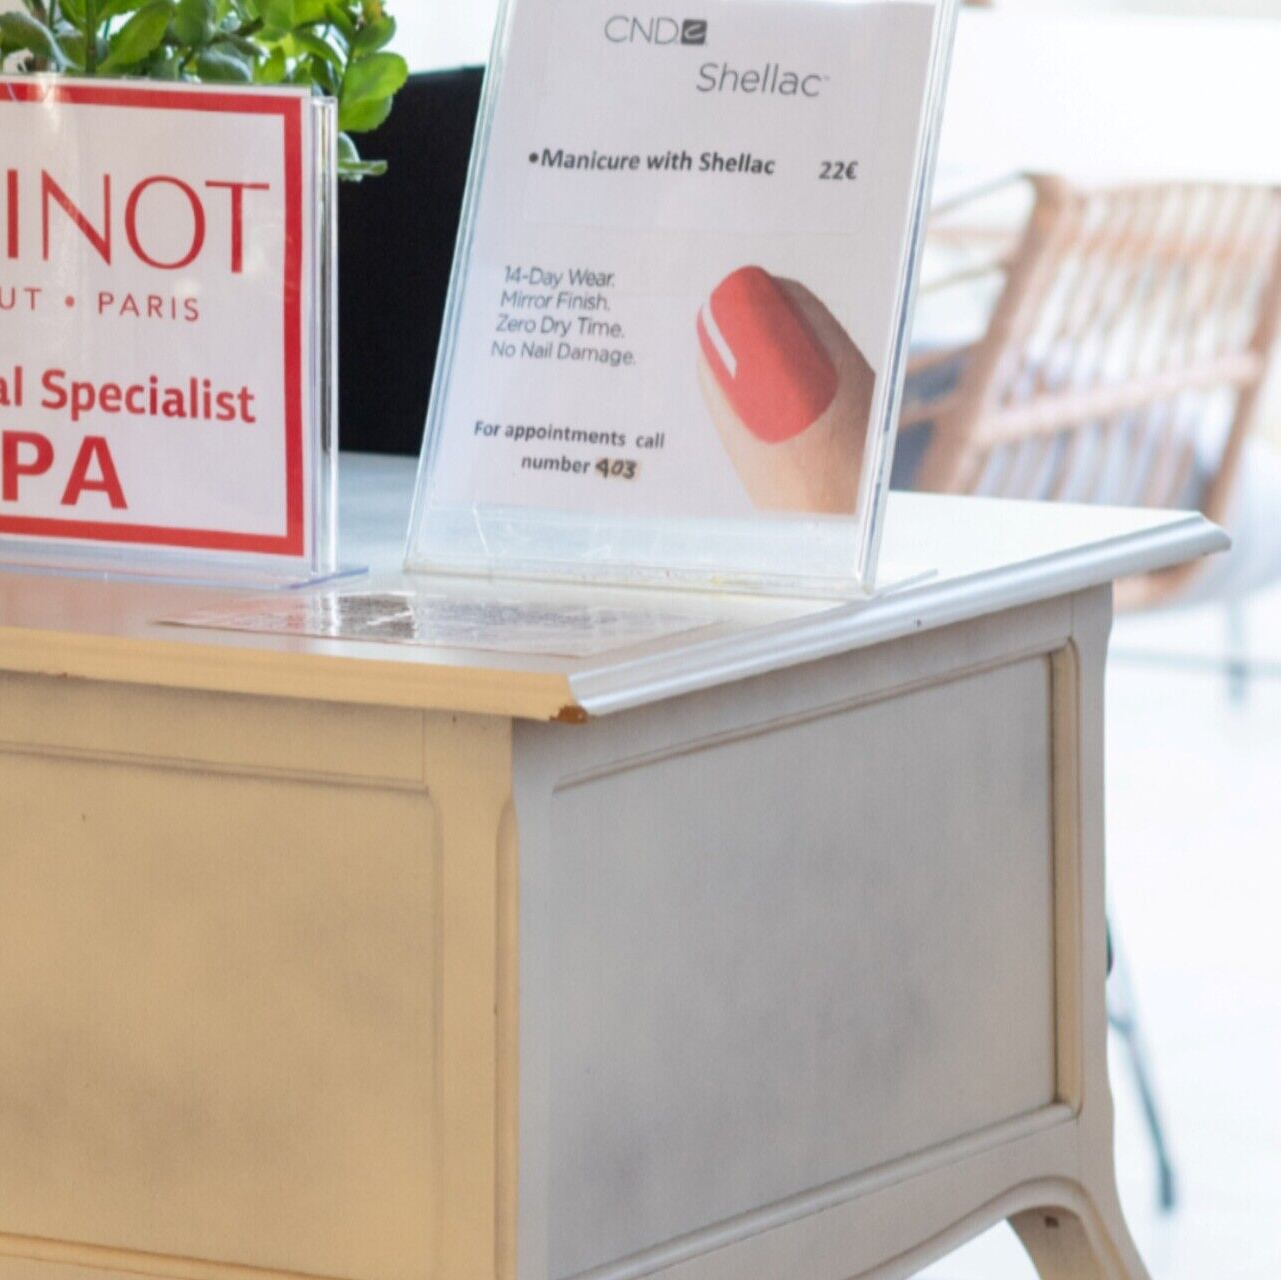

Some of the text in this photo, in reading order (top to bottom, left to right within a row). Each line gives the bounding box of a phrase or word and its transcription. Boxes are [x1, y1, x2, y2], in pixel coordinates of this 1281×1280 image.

[696, 62, 822, 98] Shellac
[647, 150, 693, 172] with
[698, 151, 776, 175] Shellac
[819, 161, 859, 181] 22€
[505, 265, 616, 290] 14-Day Wear.
[98, 292, 200, 322] PARIS
[500, 290, 611, 312] Mirror Finish.
[496, 312, 625, 339] Zero Dry Time.
[491, 340, 636, 368] No Nail Damage.
[40, 368, 256, 423] Specialist
[474, 420, 666, 450] For appointments call
[521, 454, 638, 481] number 403
